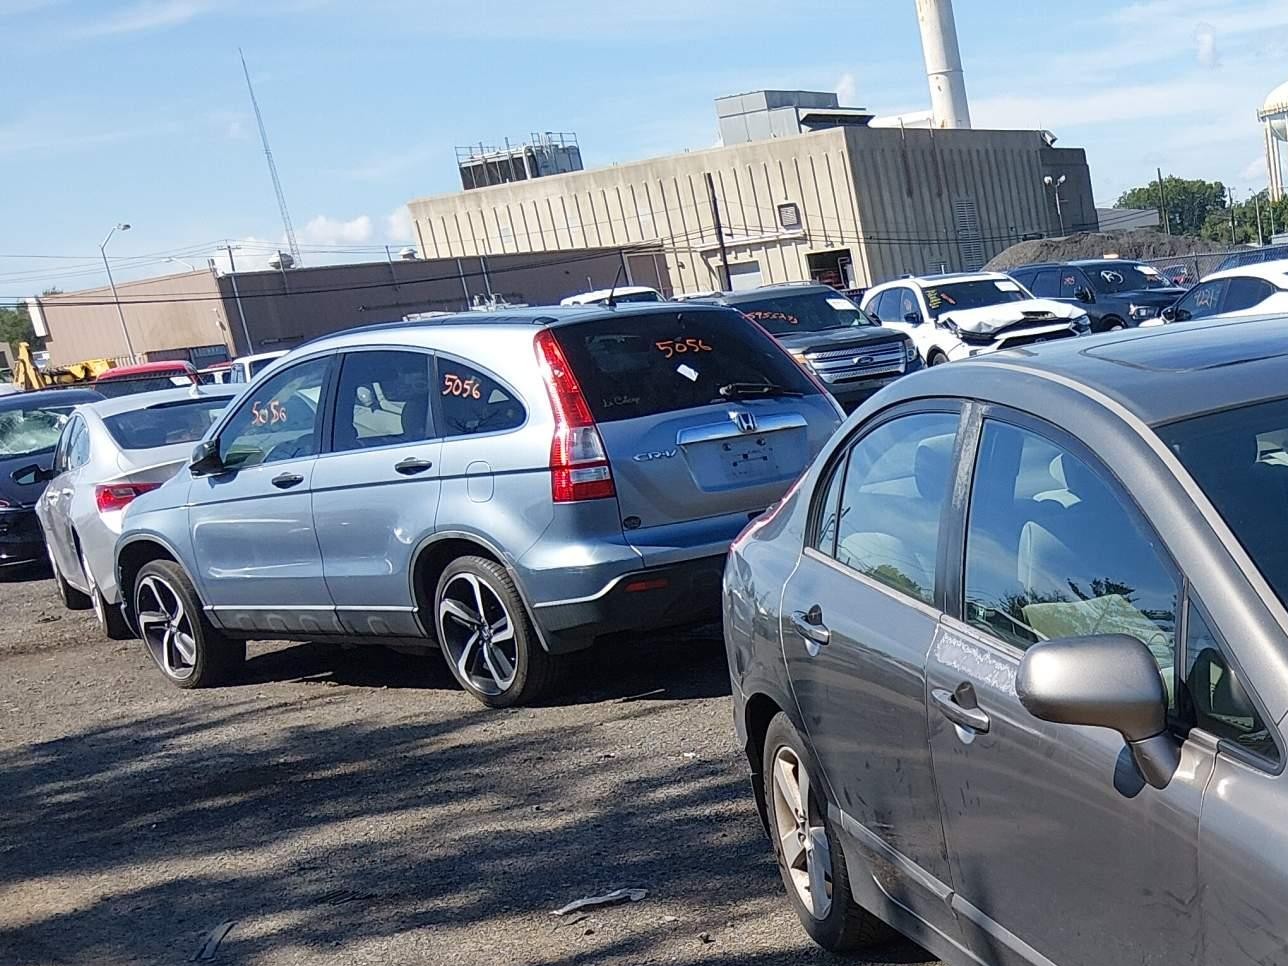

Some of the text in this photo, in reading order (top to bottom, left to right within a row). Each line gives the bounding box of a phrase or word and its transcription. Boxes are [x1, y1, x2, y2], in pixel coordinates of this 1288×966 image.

[656, 338, 713, 358] 5056
[441, 374, 481, 399] 5056
[251, 400, 288, 425] 5056
[632, 449, 677, 462] CR-V
